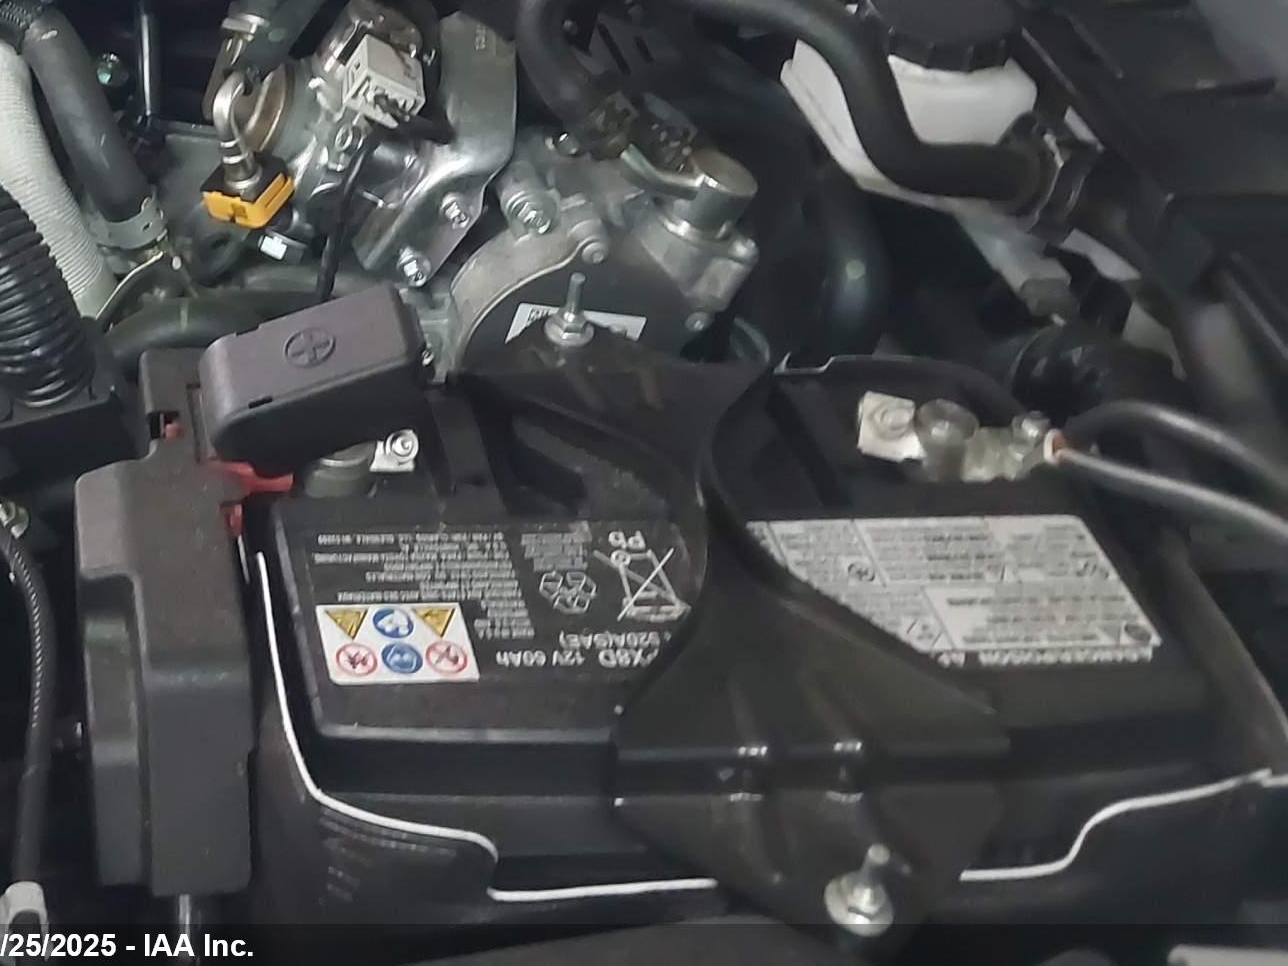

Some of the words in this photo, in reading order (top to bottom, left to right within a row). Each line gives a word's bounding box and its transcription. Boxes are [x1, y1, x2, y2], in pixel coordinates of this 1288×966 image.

[608, 531, 646, 549] Pb
[496, 650, 546, 668] 60Ah
[552, 650, 585, 667] 12V
